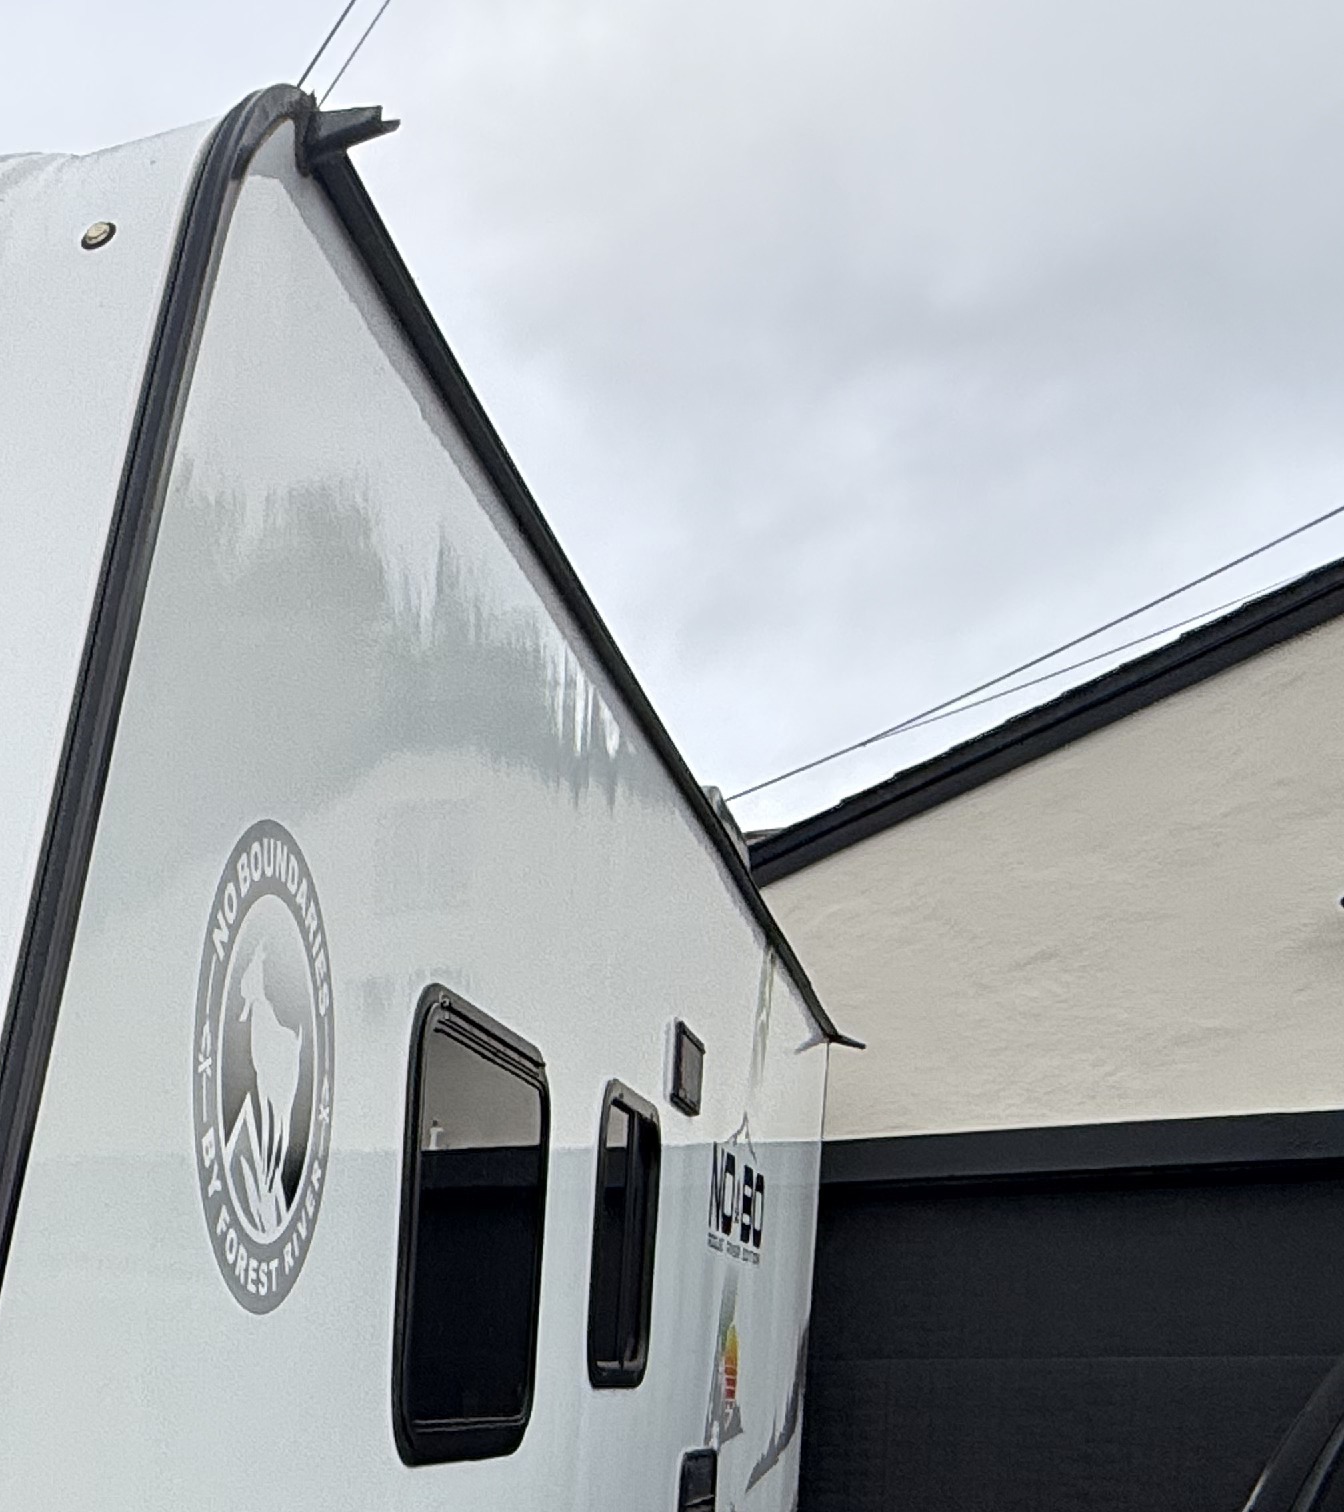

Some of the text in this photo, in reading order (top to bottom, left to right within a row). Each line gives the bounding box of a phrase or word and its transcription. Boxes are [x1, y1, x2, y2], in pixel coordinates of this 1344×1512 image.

[212, 837, 331, 1018] NO BOUNDARIES
[201, 1125, 322, 1296] BY FOREST RIVER
